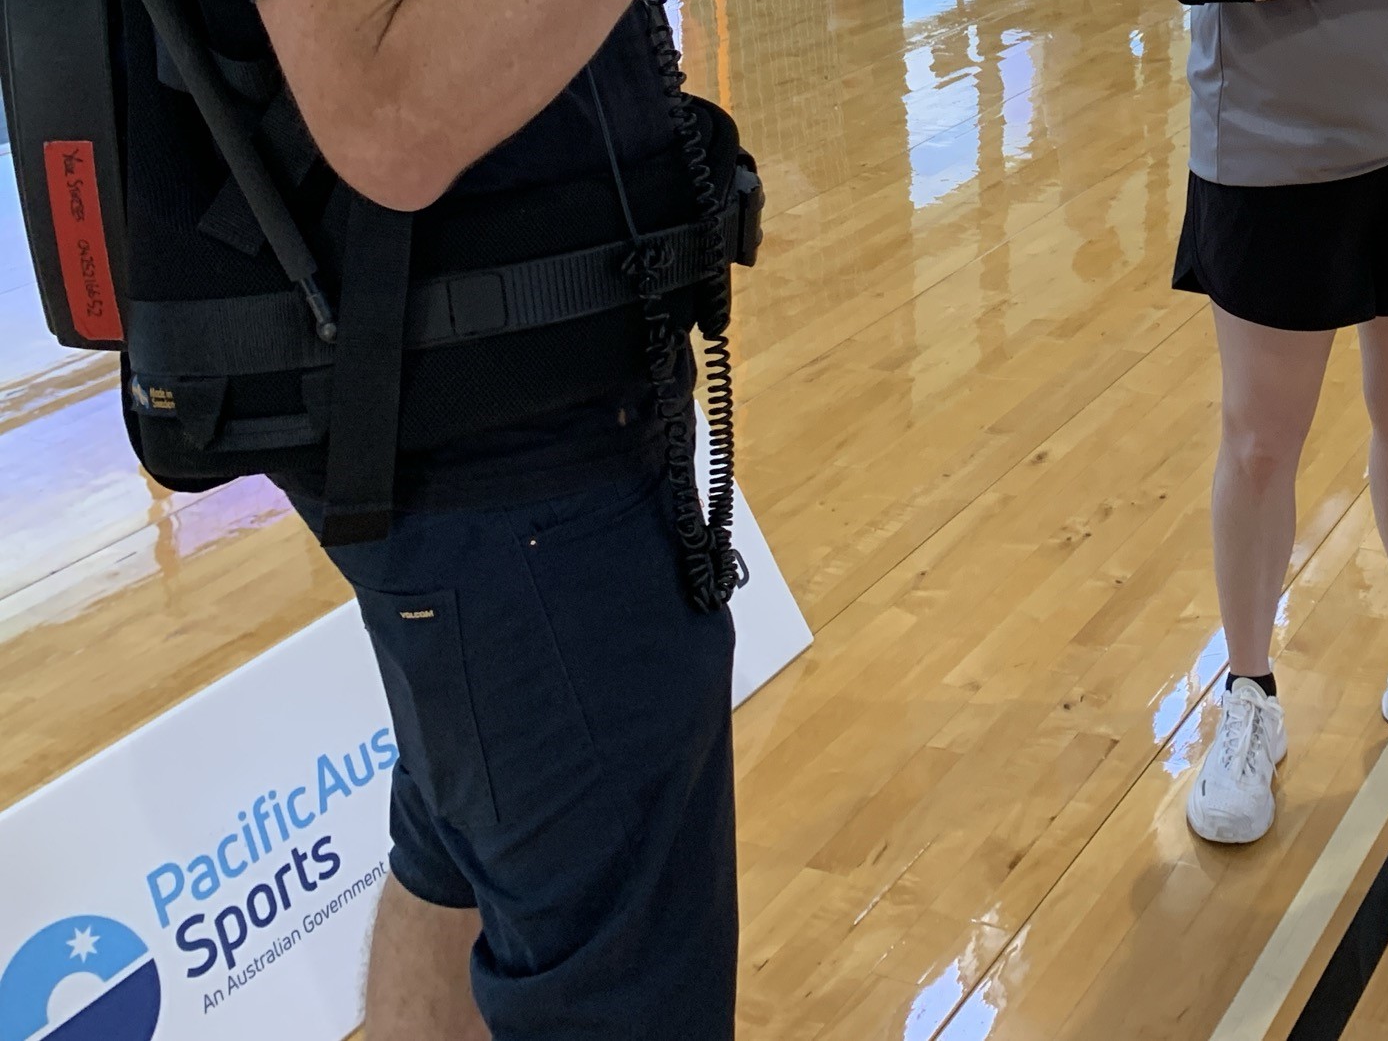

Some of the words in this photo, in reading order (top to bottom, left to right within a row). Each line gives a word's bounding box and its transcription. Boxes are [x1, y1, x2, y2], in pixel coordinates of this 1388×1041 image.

[151, 398, 176, 409] Sweden
[175, 835, 341, 979] Sports
[203, 988, 225, 1015] An
[227, 928, 302, 996] Australian
[302, 860, 388, 935] Government
